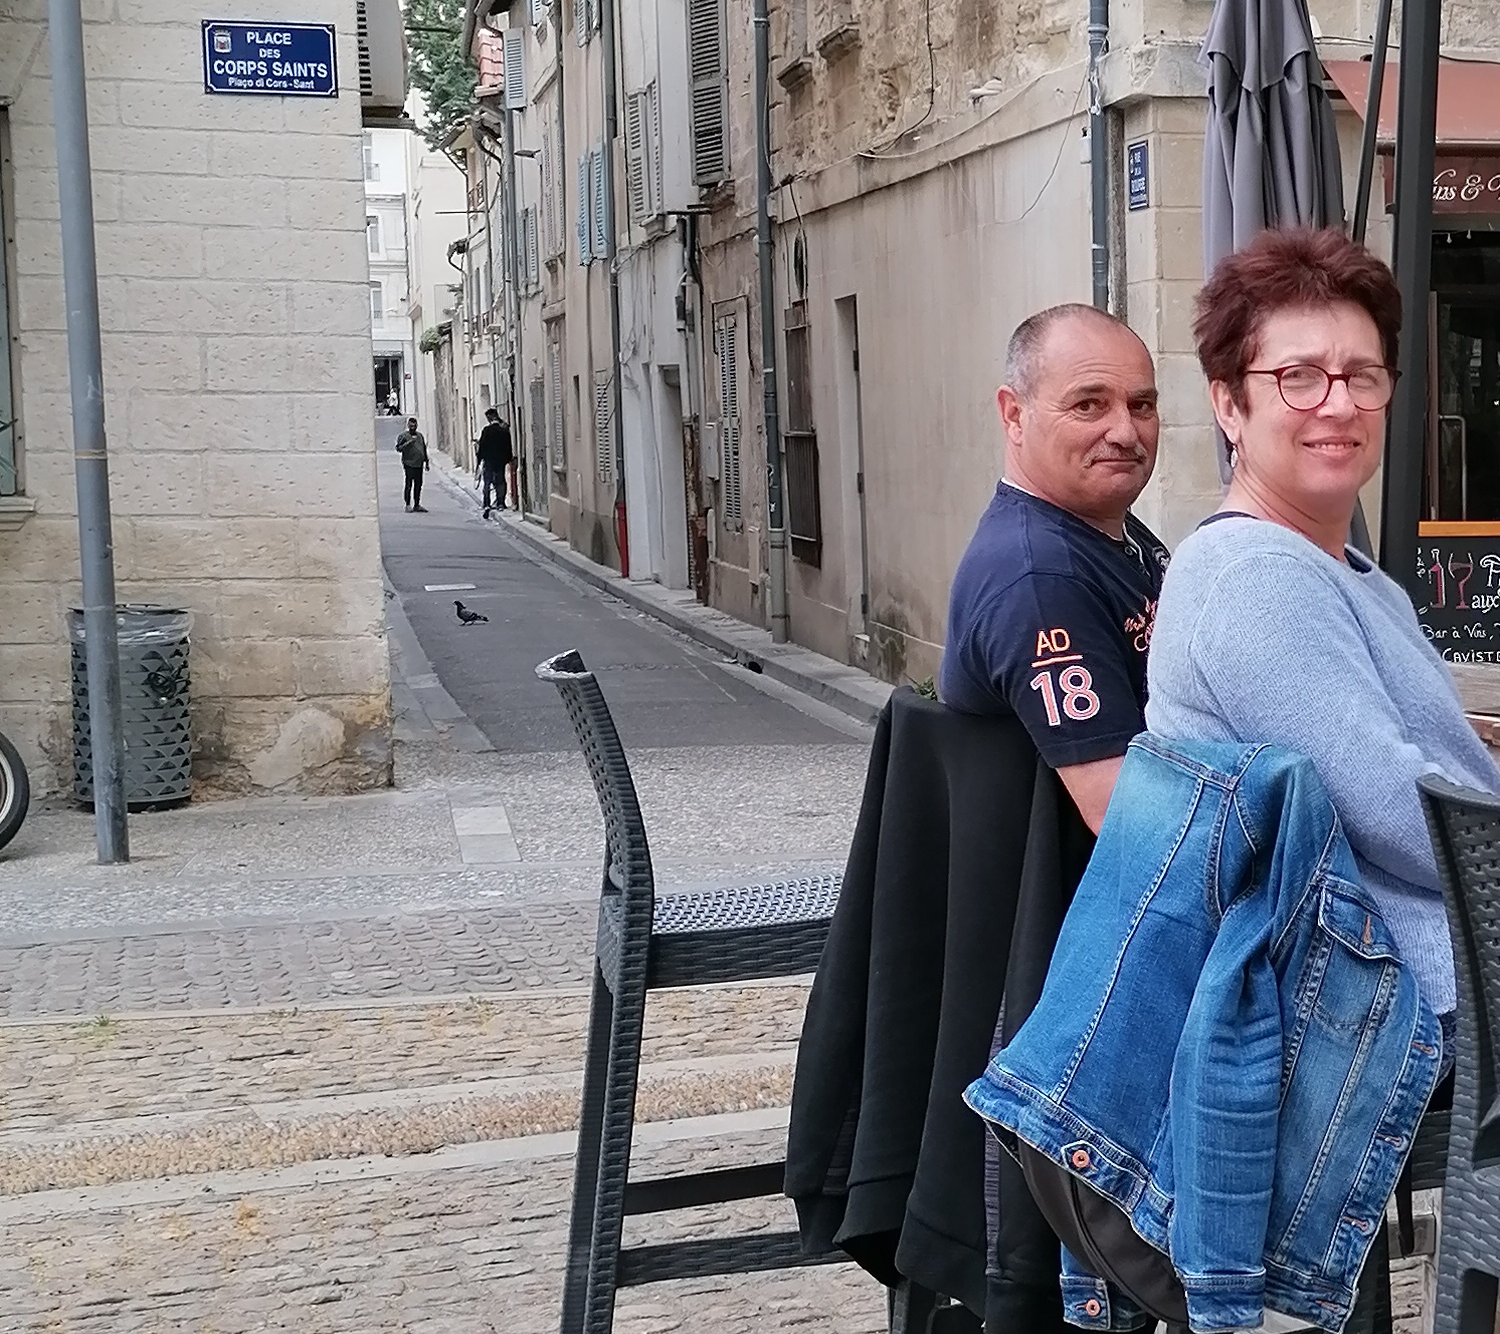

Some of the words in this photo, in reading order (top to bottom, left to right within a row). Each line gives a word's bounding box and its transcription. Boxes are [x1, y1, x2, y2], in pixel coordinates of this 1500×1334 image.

[246, 31, 292, 45] PLACE
[259, 48, 281, 58] DES
[213, 60, 268, 76] CORPS
[272, 62, 328, 78] SAINTS
[1460, 174, 1485, 201] &
[1471, 593, 1500, 614] aux
[1036, 628, 1071, 657] AD
[1452, 627, 1461, 639] à
[1030, 665, 1101, 727] 18
